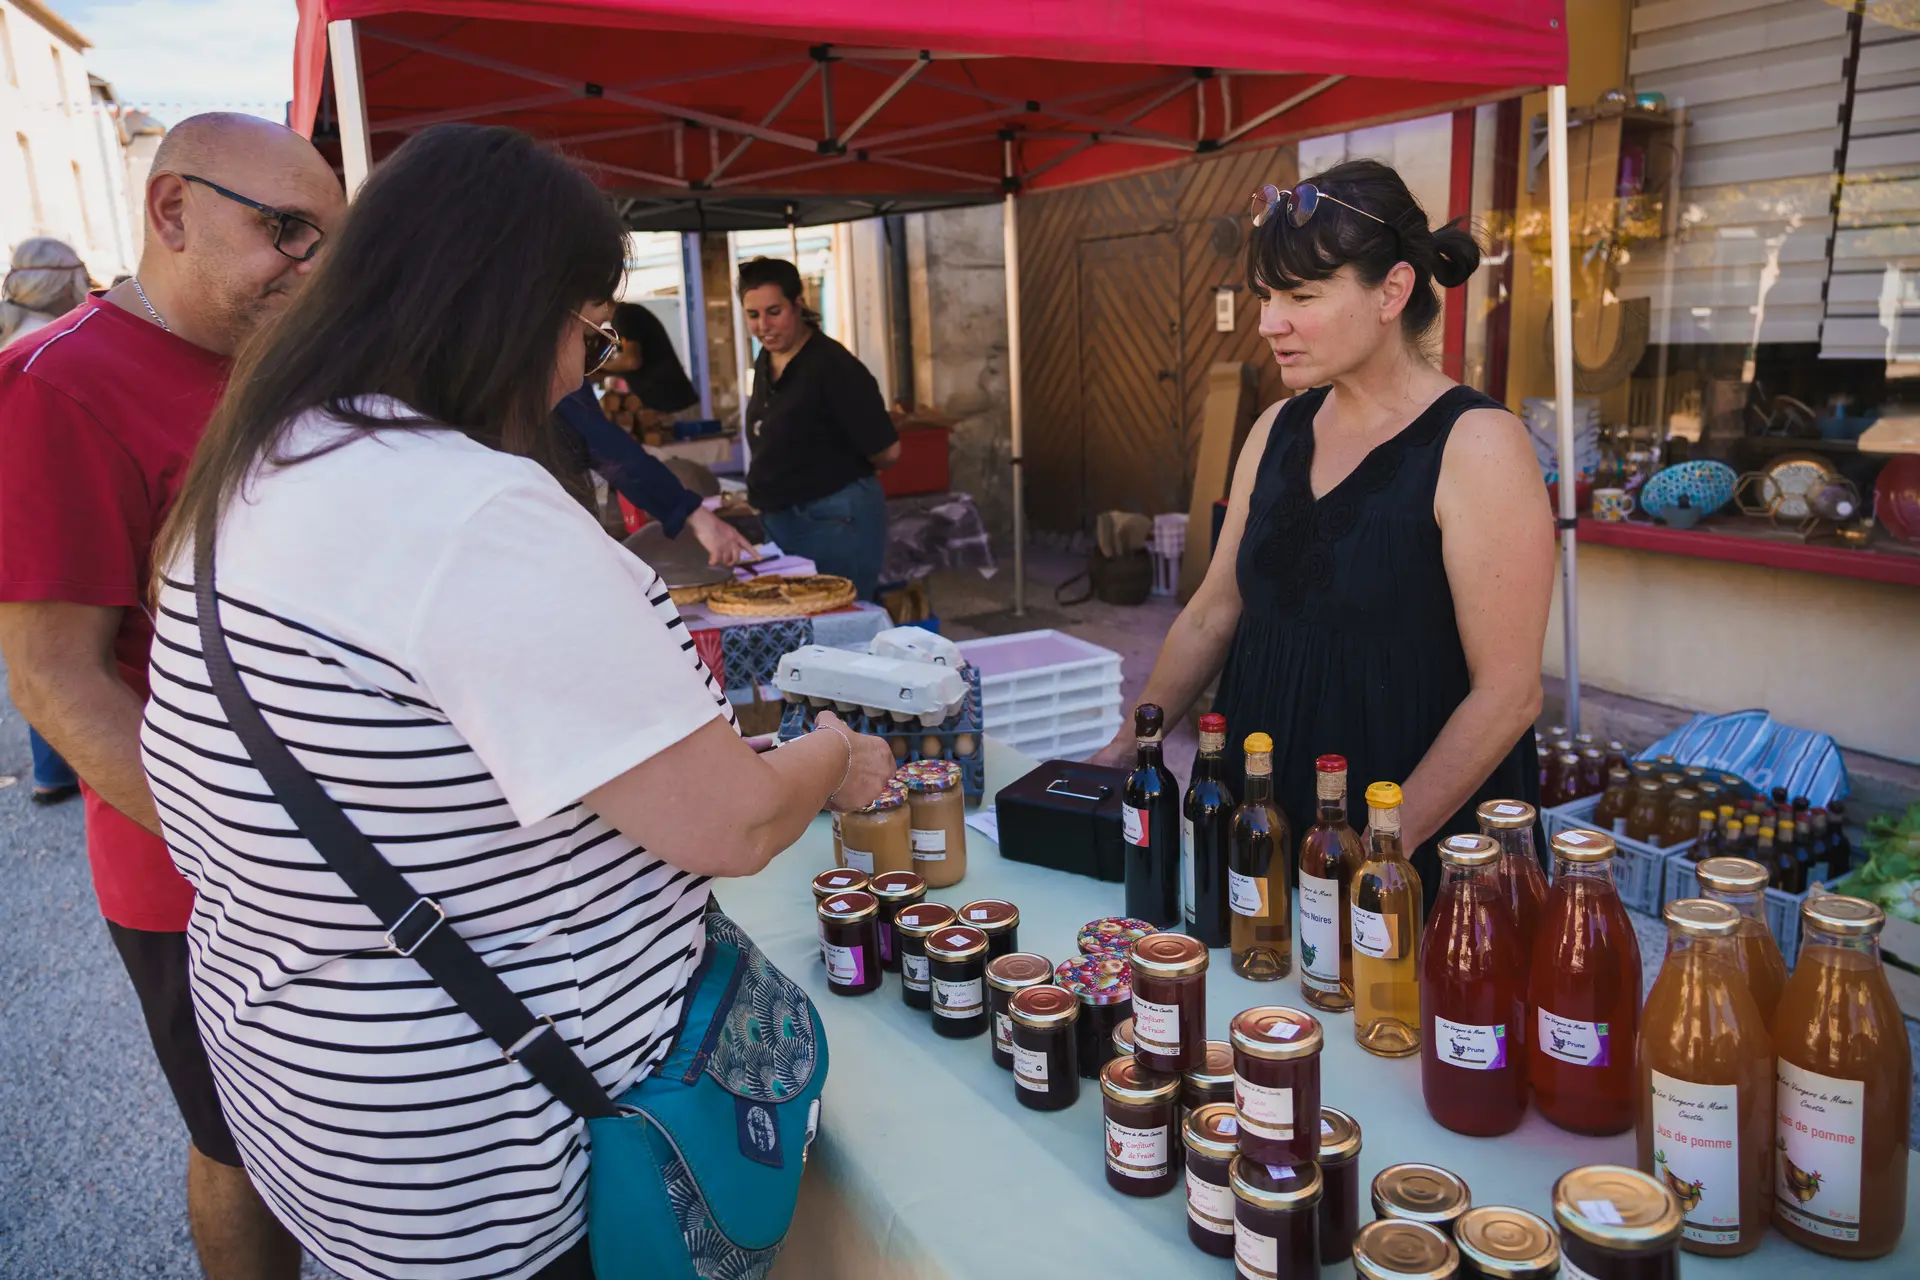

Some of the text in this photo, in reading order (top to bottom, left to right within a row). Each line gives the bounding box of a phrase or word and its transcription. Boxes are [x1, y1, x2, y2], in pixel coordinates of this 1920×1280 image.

[1311, 912, 1332, 924] Noires
[1140, 1012, 1165, 1023] Confiture
[1148, 1026, 1166, 1034] Fraise
[1567, 1040, 1586, 1049] Prune
[1656, 1089, 1666, 1099] Les
[1668, 1093, 1695, 1107] Vergers
[1706, 1102, 1729, 1110] Mamie
[1791, 1081, 1818, 1097] Vergers
[1820, 1093, 1828, 1101] de
[1829, 1095, 1853, 1105] Mamie
[1800, 1099, 1825, 1113] Cocotte
[1678, 1109, 1704, 1122] Cocotte
[1778, 1111, 1855, 1144] Jus de pomme
[1656, 1123, 1733, 1149] Jus de pomme
[1126, 1141, 1155, 1151] Confiture
